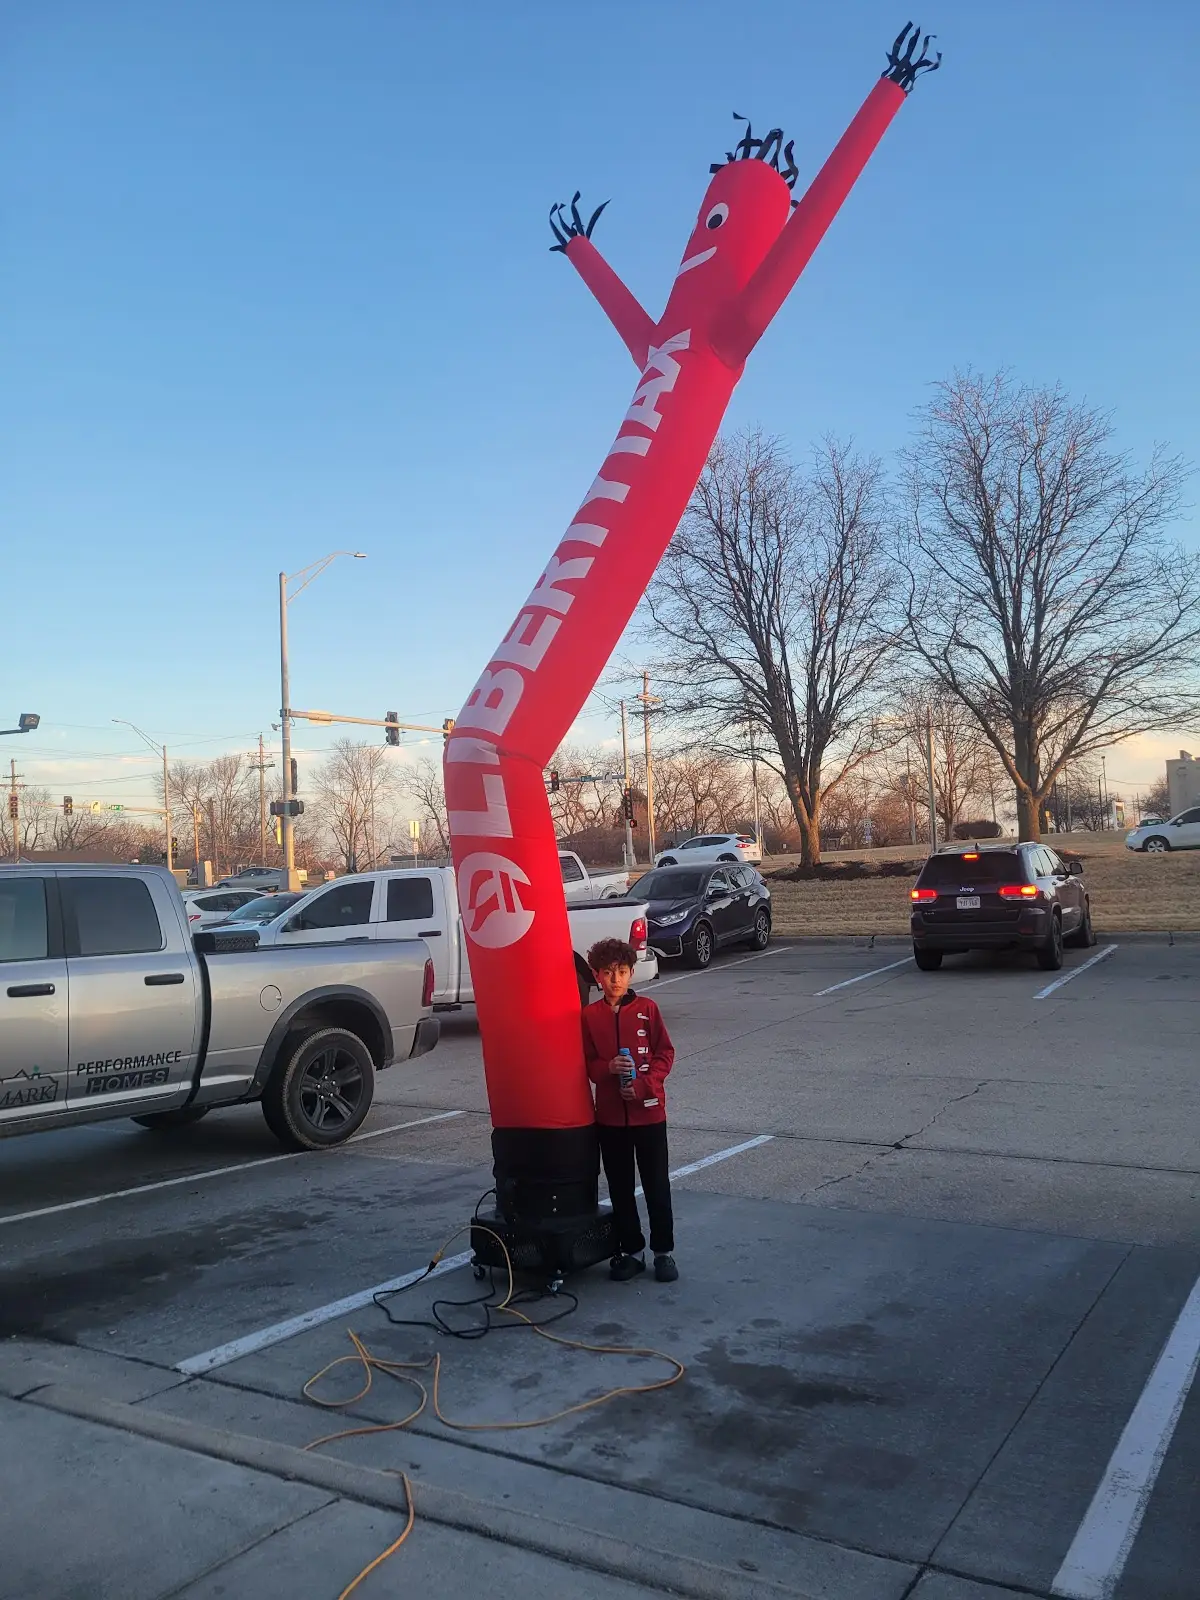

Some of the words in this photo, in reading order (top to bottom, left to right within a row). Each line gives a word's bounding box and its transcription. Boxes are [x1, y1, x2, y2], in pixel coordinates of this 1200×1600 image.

[76, 1050, 182, 1076] PERFORMANCE
[637, 1012, 659, 1108] JORDN
[88, 1070, 166, 1093] HOMES
